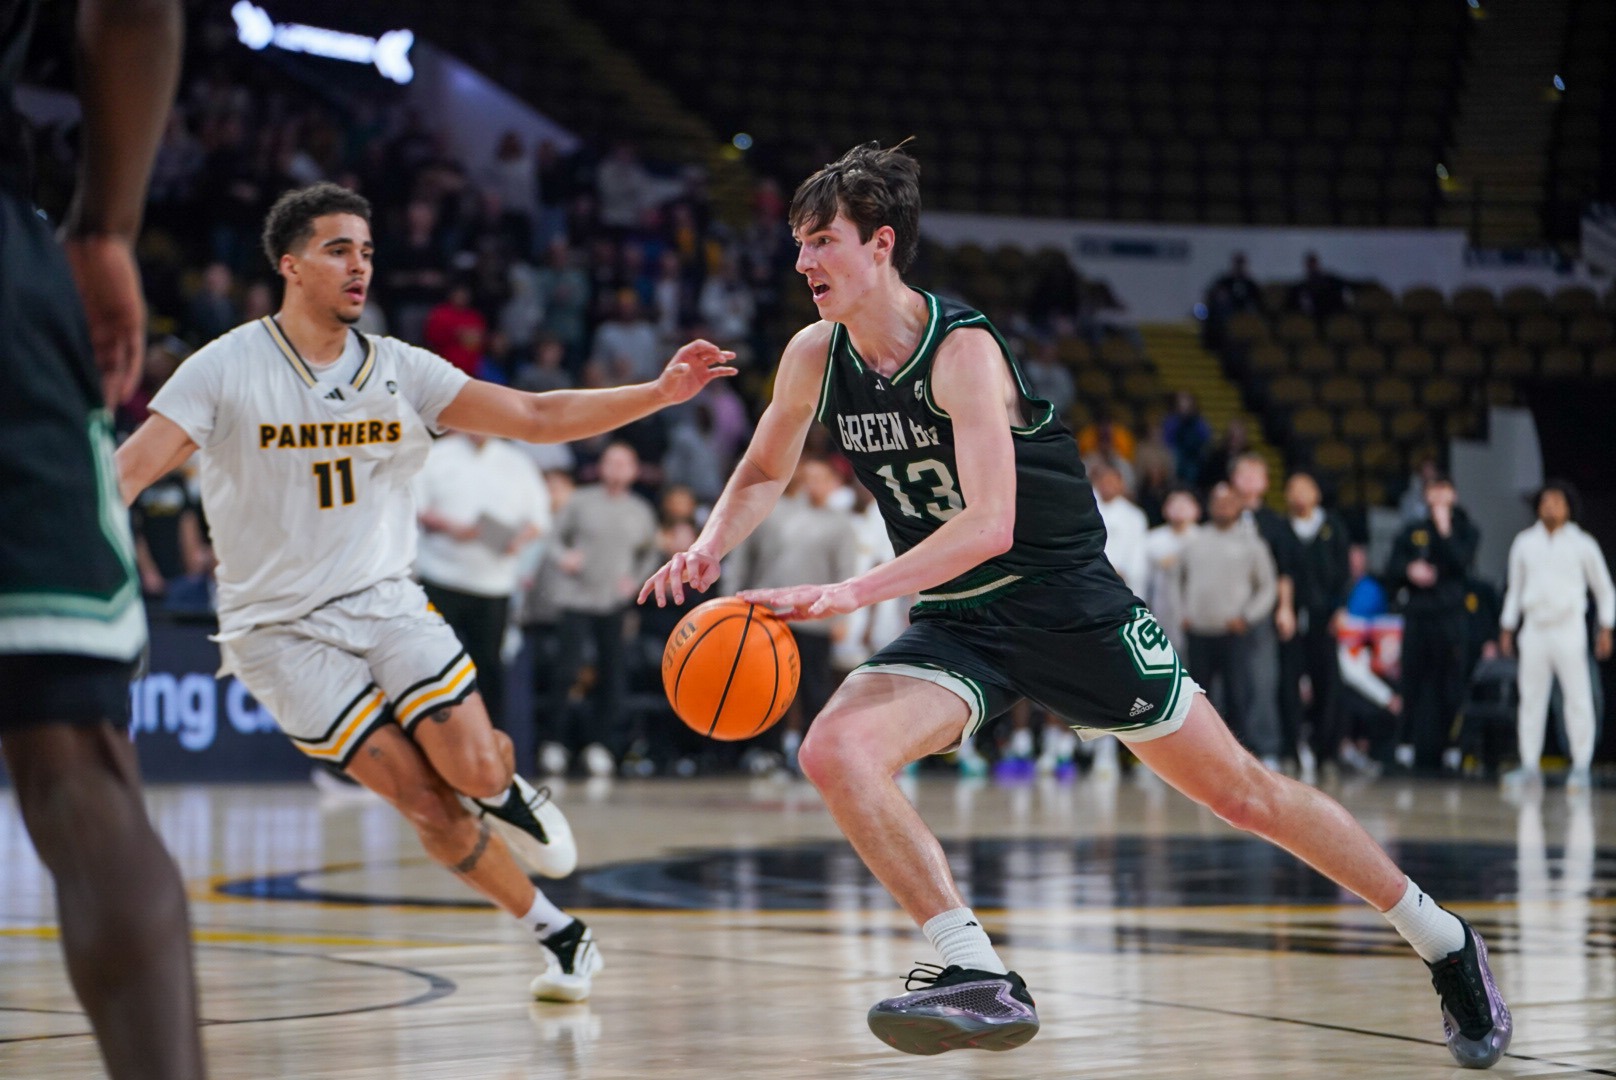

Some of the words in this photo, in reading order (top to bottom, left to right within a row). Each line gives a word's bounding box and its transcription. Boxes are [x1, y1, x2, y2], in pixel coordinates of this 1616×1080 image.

[259, 420, 402, 449] PANTHERS
[837, 412, 909, 453] GREEN
[312, 457, 356, 510] 11
[876, 459, 963, 522] 13
[1129, 703, 1154, 717] adidas
